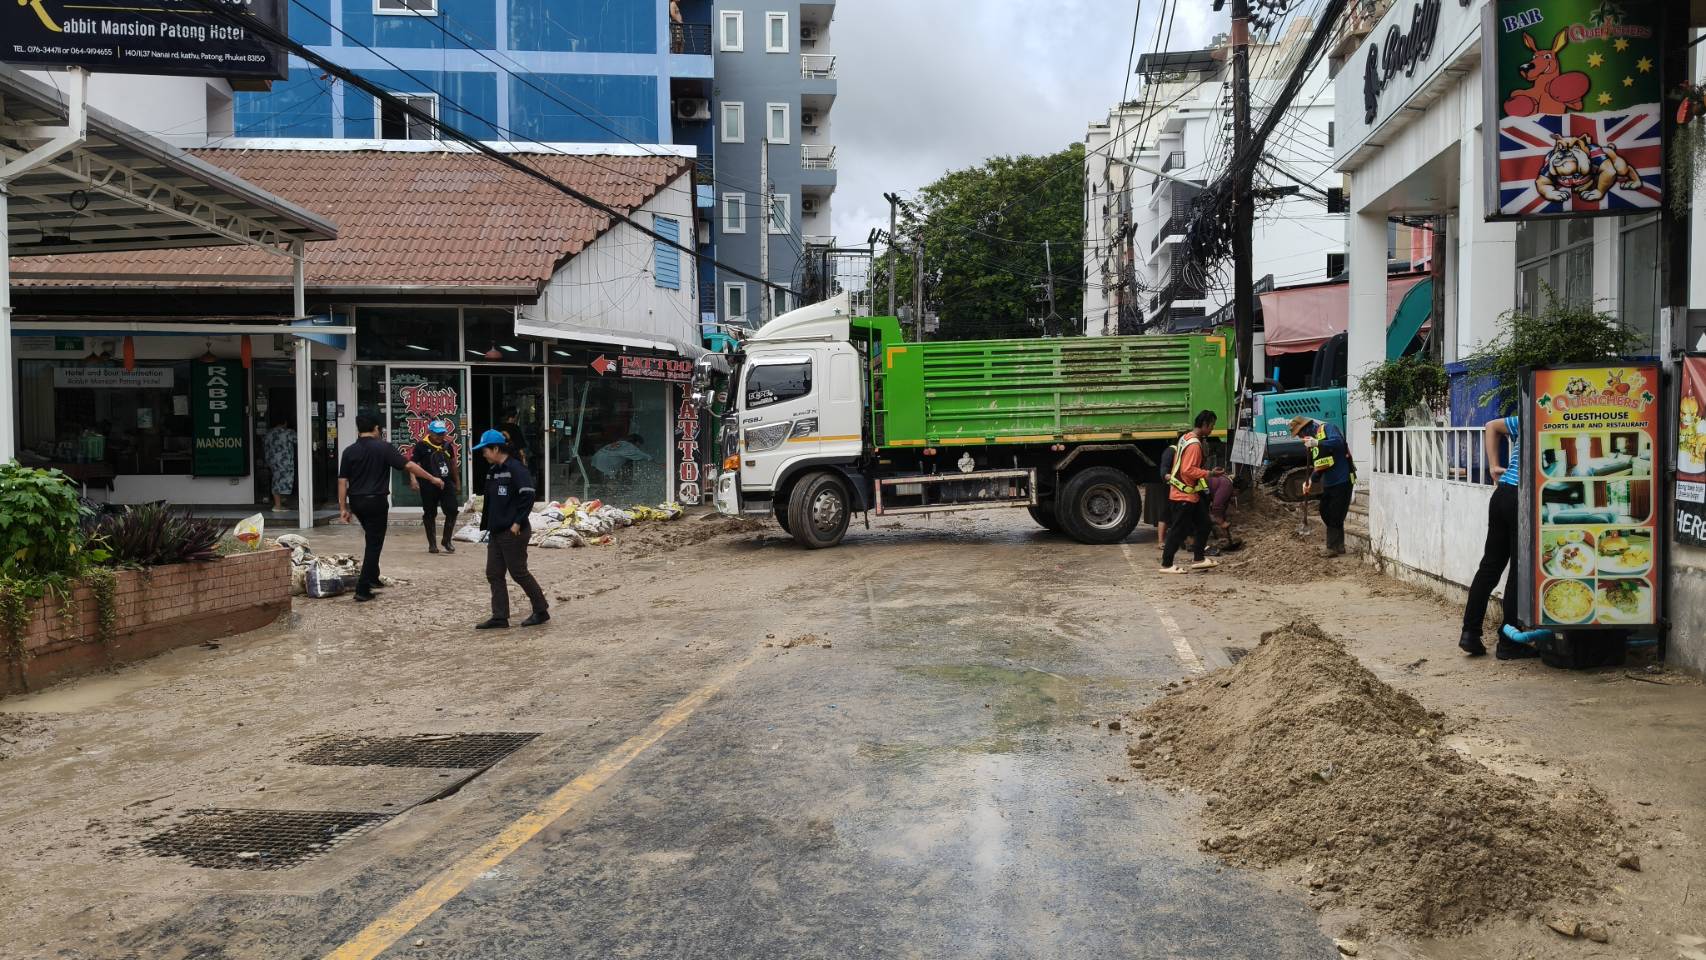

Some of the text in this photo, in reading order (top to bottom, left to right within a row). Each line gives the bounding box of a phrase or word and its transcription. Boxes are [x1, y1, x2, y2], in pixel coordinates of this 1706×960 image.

[1503, 8, 1544, 33] BAR
[101, 20, 155, 37] Mansion
[160, 23, 206, 42] Patong
[210, 24, 245, 40] Hotel
[207, 366, 229, 437] RABBIT
[1553, 394, 1639, 412] QUENCHERS
[1563, 412, 1629, 421] GUESTHOUSE
[1606, 421, 1649, 429] RESTAURANT
[196, 438, 242, 449] MANSION
[1676, 509, 1706, 540] HERE
